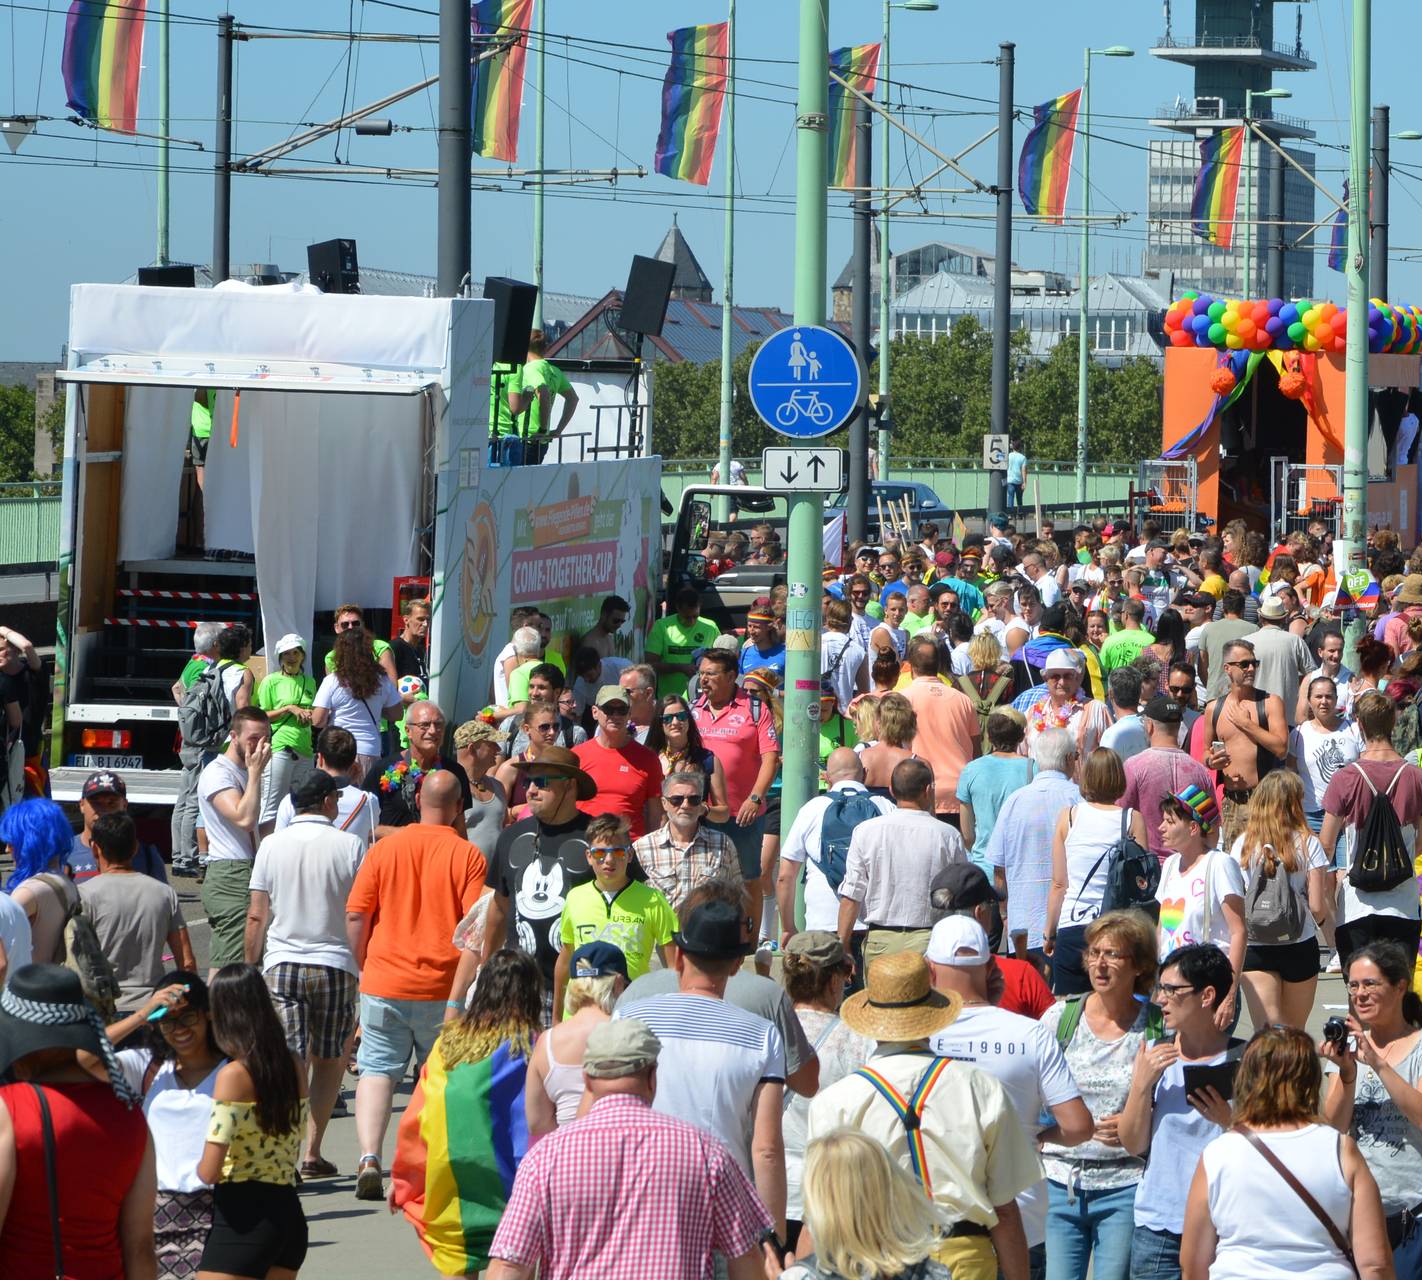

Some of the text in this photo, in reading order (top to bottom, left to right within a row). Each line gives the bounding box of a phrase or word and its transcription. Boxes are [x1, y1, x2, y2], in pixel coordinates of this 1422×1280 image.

[990, 439, 1003, 465] 5
[513, 550, 614, 594] COME-TOGETHER-CUP
[114, 757, 142, 769] 6947
